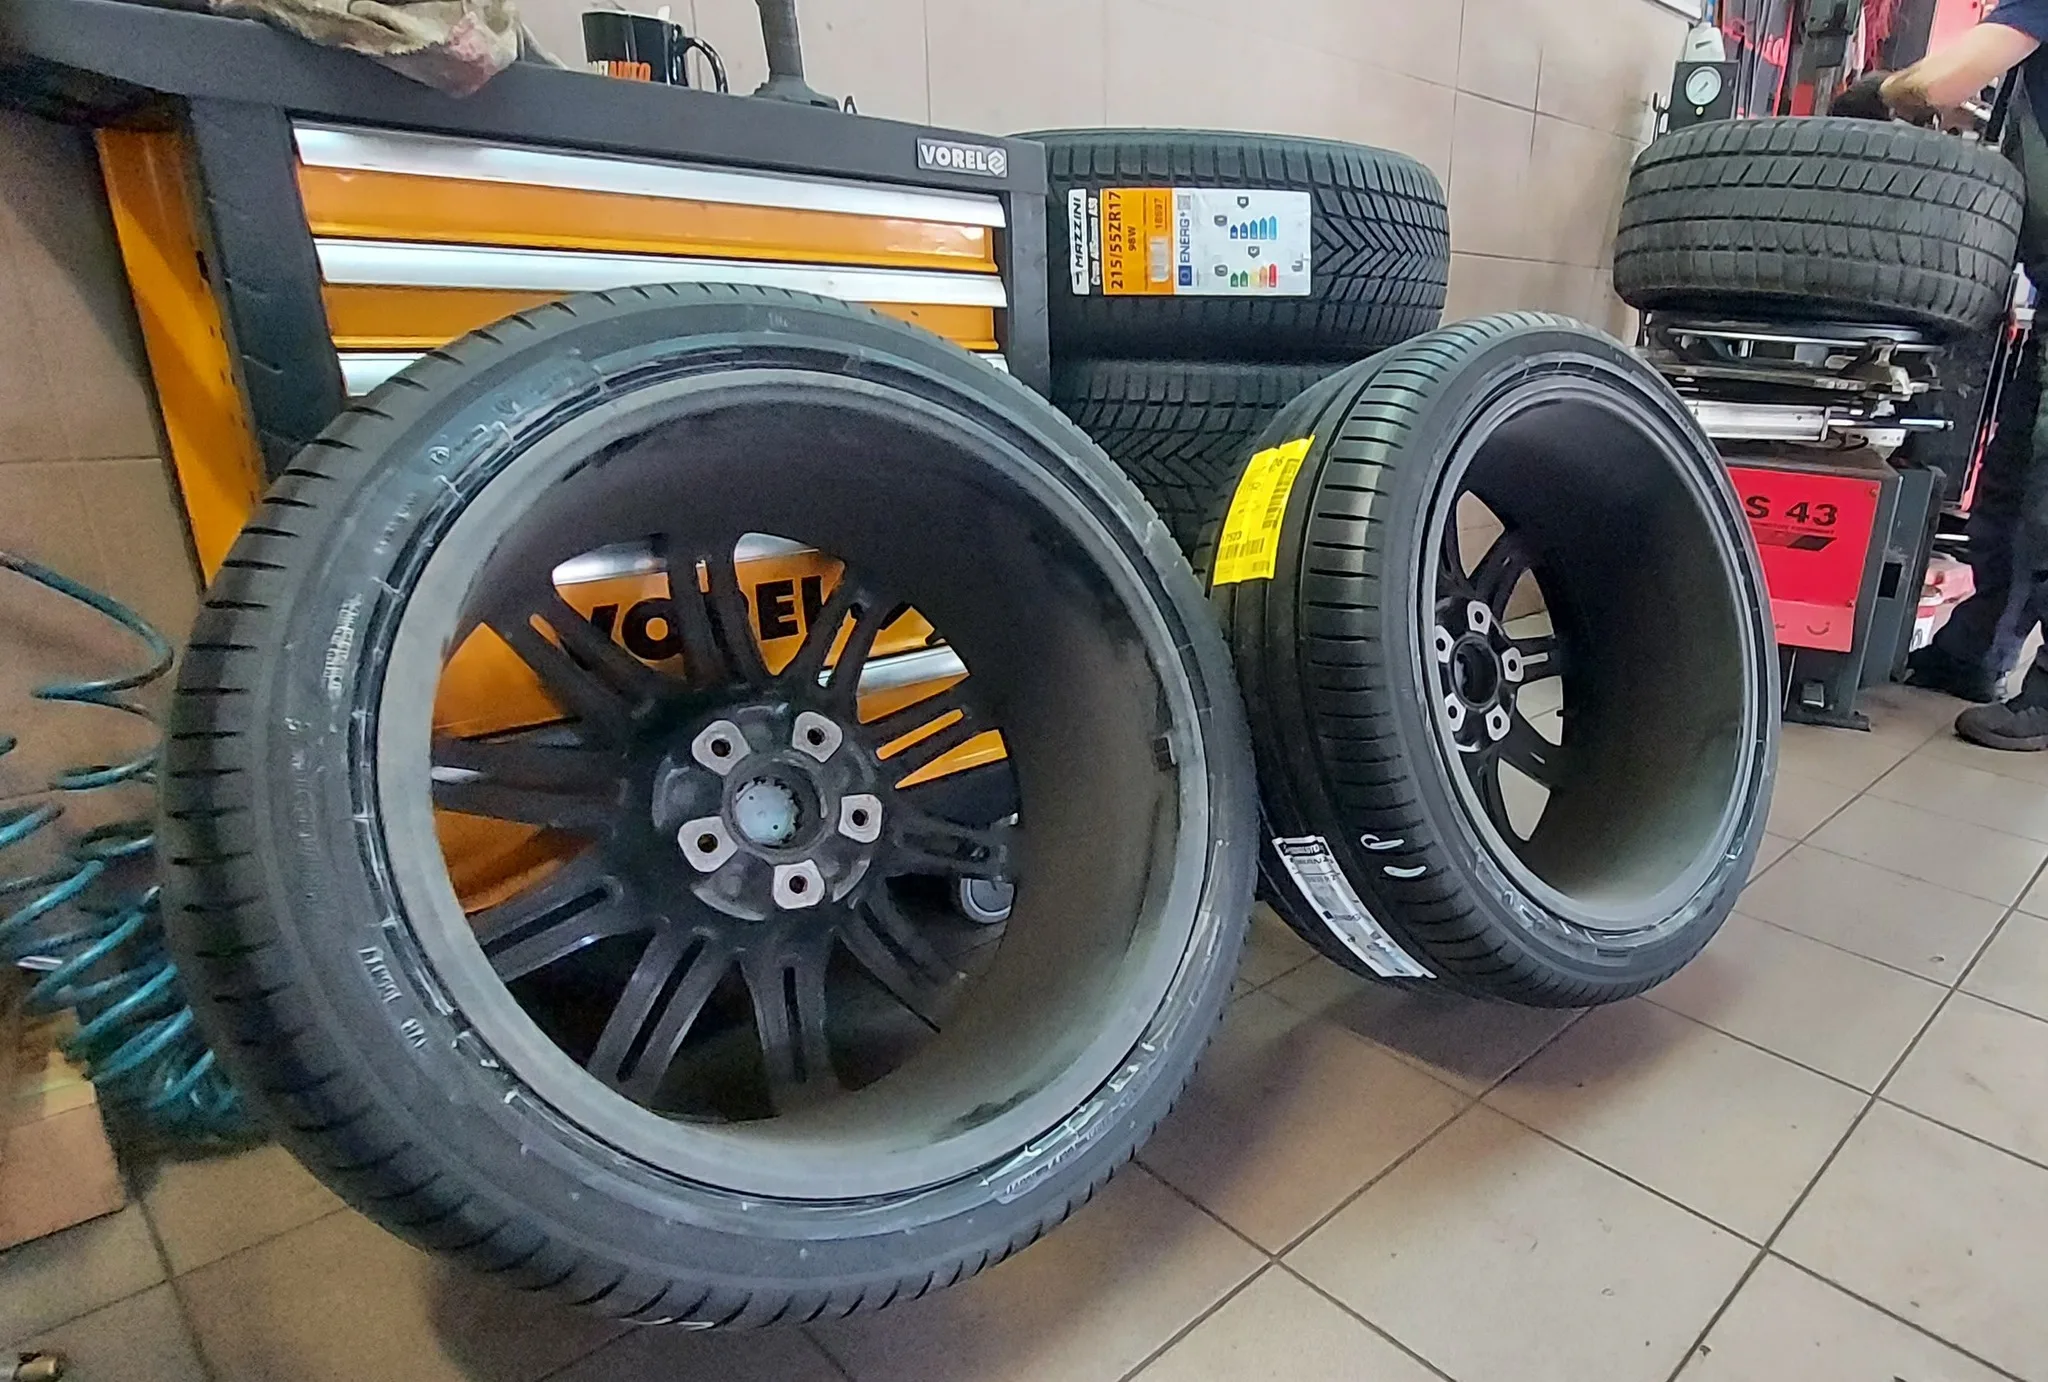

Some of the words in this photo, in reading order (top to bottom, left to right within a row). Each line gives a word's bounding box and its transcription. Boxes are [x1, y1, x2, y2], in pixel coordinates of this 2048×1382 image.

[920, 144, 987, 171] VOREL
[1074, 197, 1085, 269] MAZZINI
[1110, 191, 1124, 289] 215/55ZR17
[1180, 218, 1191, 263] ENERG
[1745, 495, 1771, 519] S
[1785, 501, 1838, 527] 43
